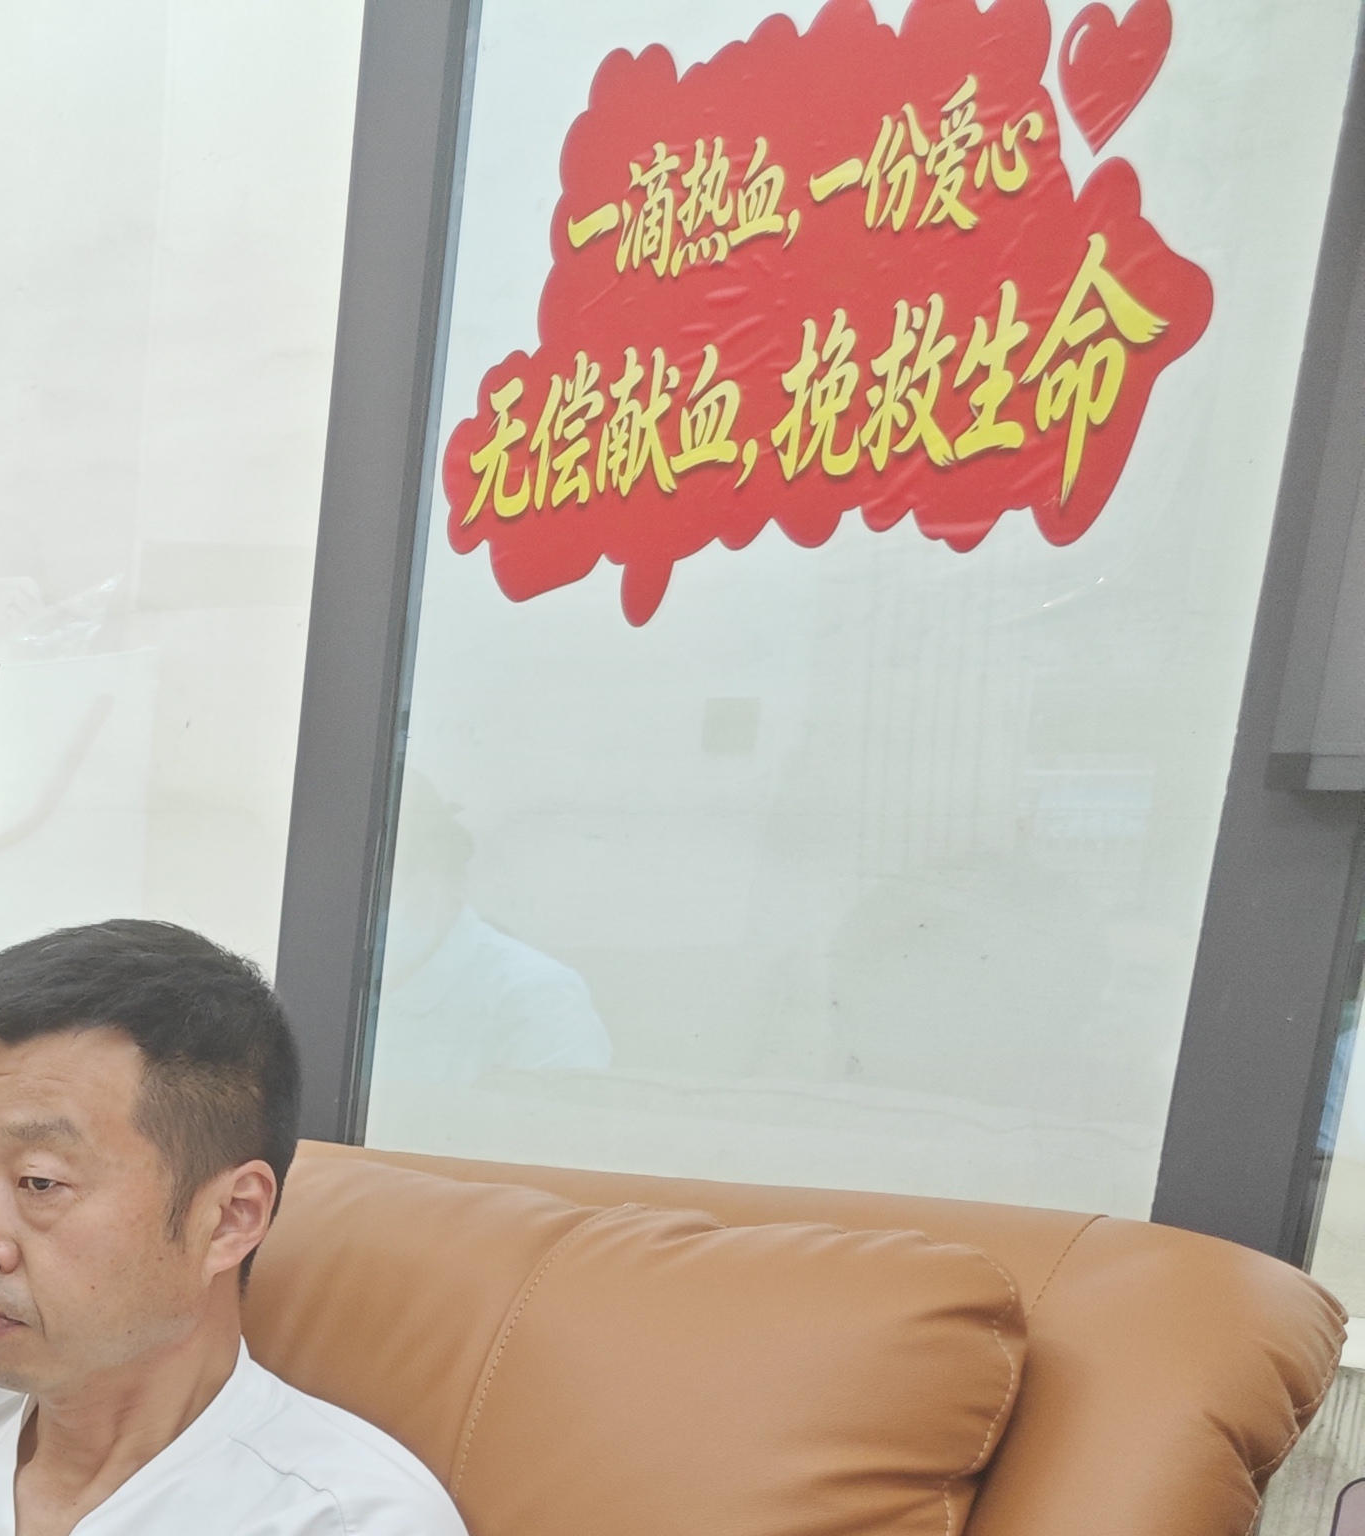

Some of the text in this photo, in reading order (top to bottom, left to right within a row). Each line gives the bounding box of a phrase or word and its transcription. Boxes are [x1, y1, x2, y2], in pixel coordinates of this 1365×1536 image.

[568, 75, 1043, 277] 一滴热血，一份爱心
[461, 233, 1169, 527] 无偿献血，挽救生命
